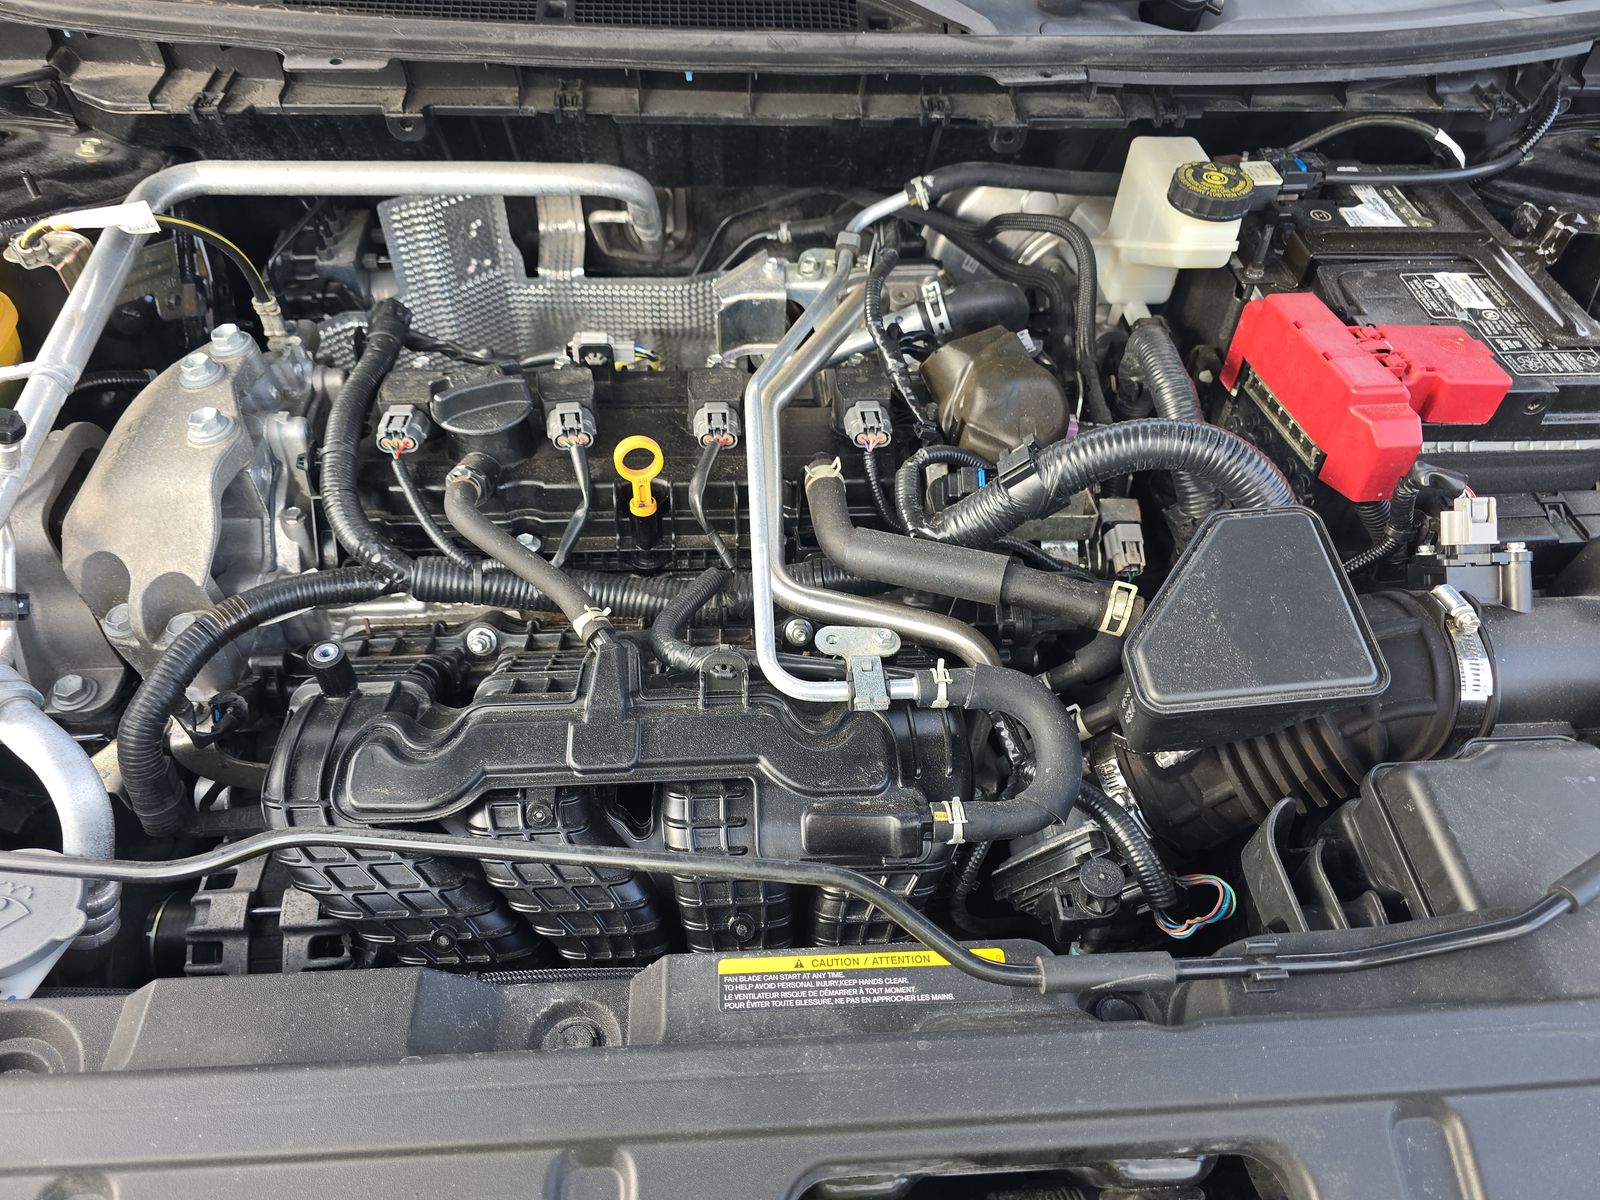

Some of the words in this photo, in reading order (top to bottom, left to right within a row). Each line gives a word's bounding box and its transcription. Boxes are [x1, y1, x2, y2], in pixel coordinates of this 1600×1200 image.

[811, 958, 860, 968] CAUTION
[864, 957, 868, 966] /
[872, 955, 931, 966] ATTENTION
[820, 988, 857, 997] DÉMARRER
[746, 1000, 770, 1009] ÉVITER
[795, 998, 834, 1006] BLESSURE,
[872, 995, 916, 1003] APPROCHER
